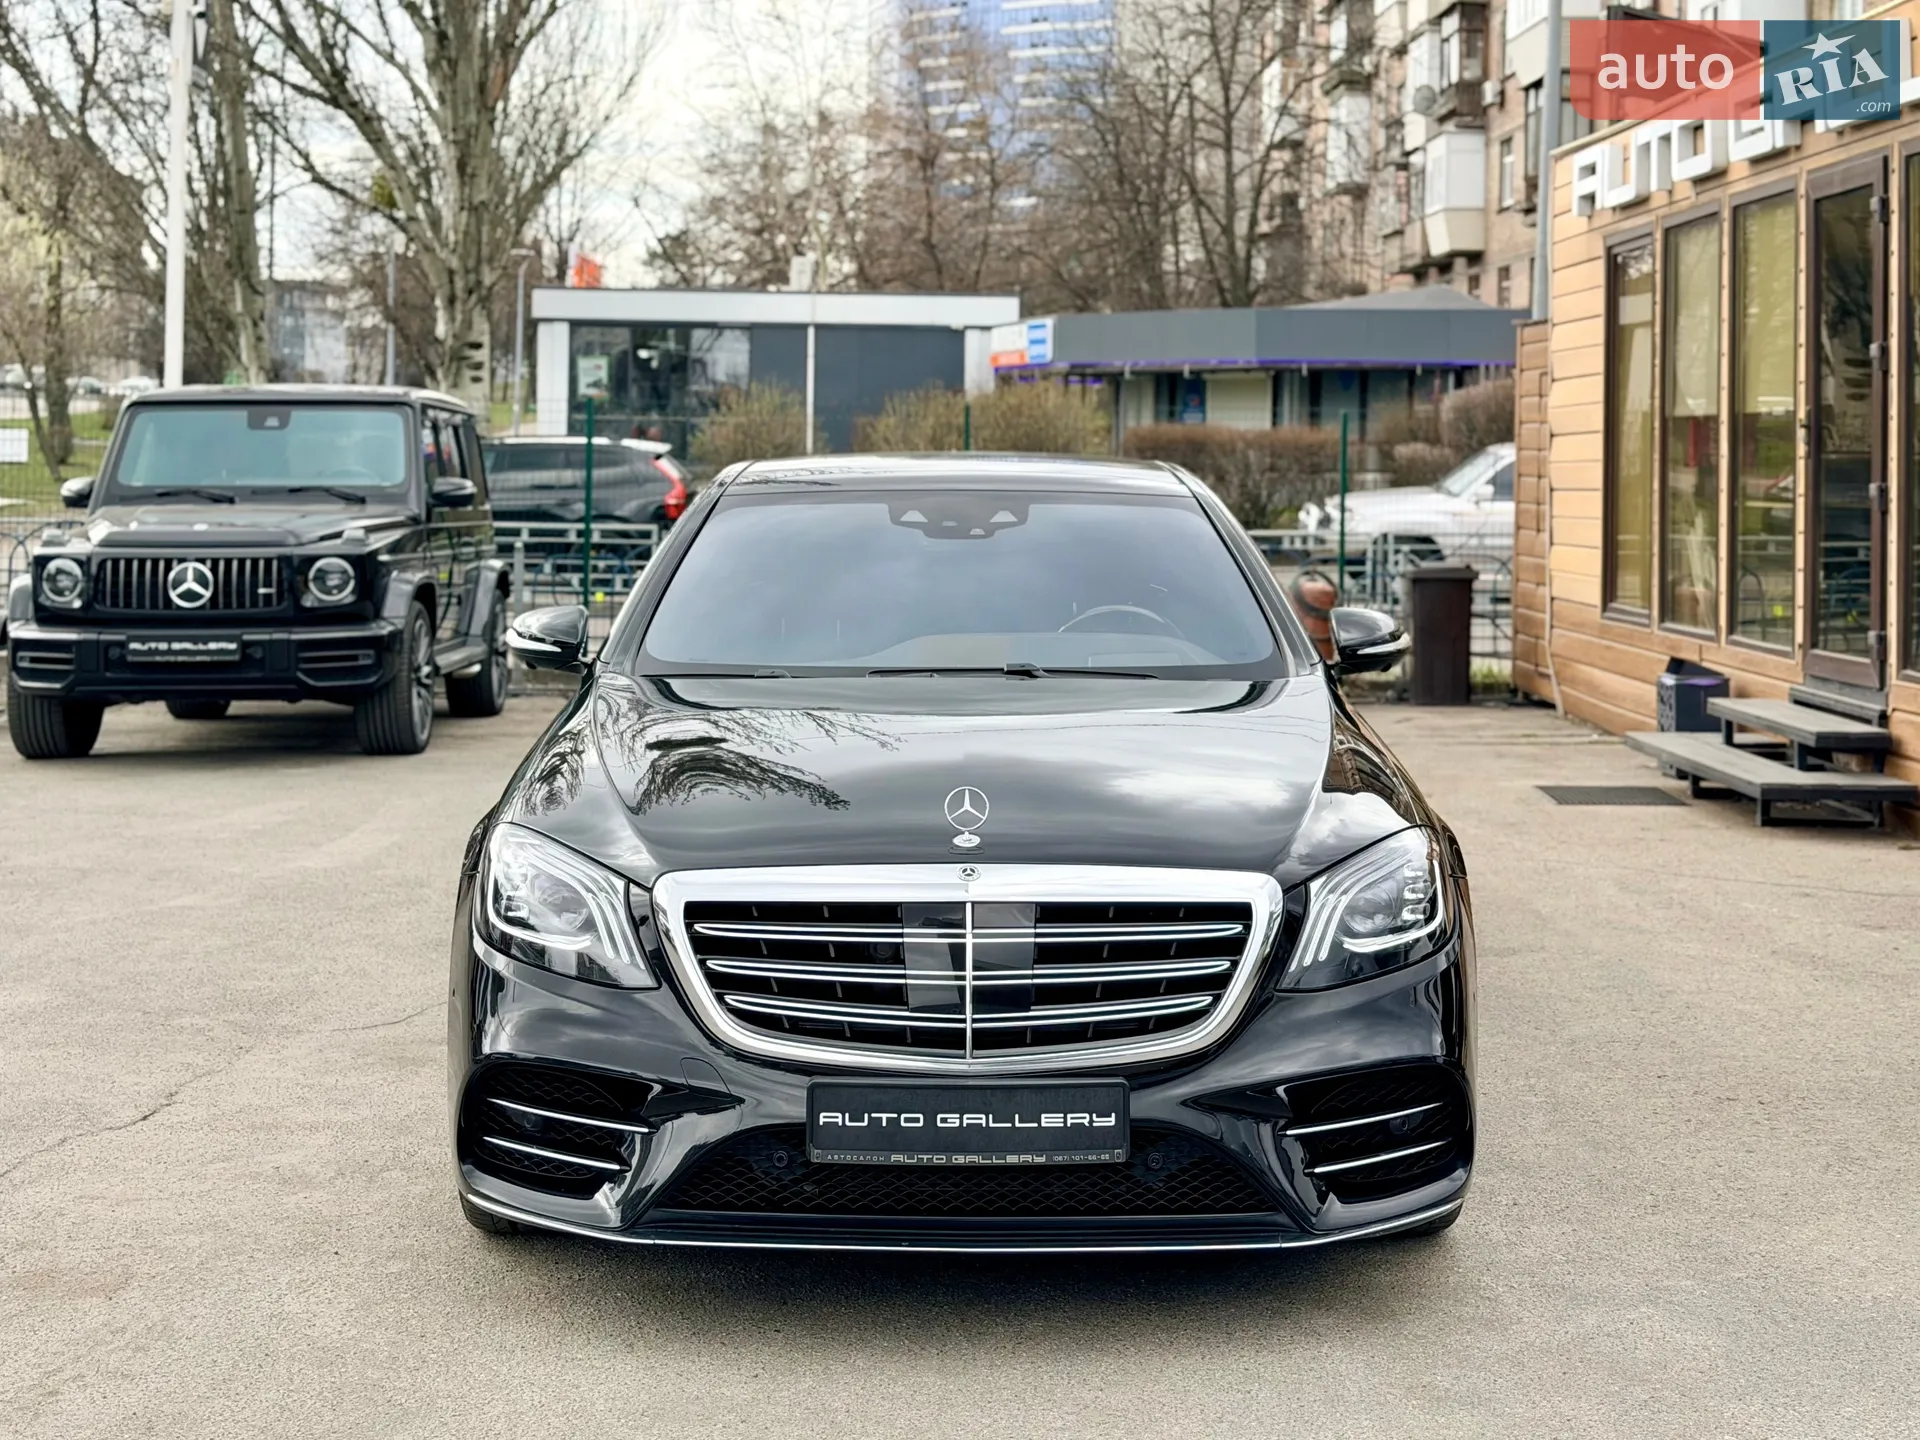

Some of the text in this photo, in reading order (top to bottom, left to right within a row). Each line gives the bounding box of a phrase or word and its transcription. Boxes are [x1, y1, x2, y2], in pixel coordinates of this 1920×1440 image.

[128, 642, 169, 651] AUTO
[819, 1112, 1116, 1127] AUTO GALLERY
[827, 1154, 885, 1162] АВТОСАЛОН
[890, 1154, 947, 1163] AUTO
[952, 1154, 1046, 1163] GALLERY
